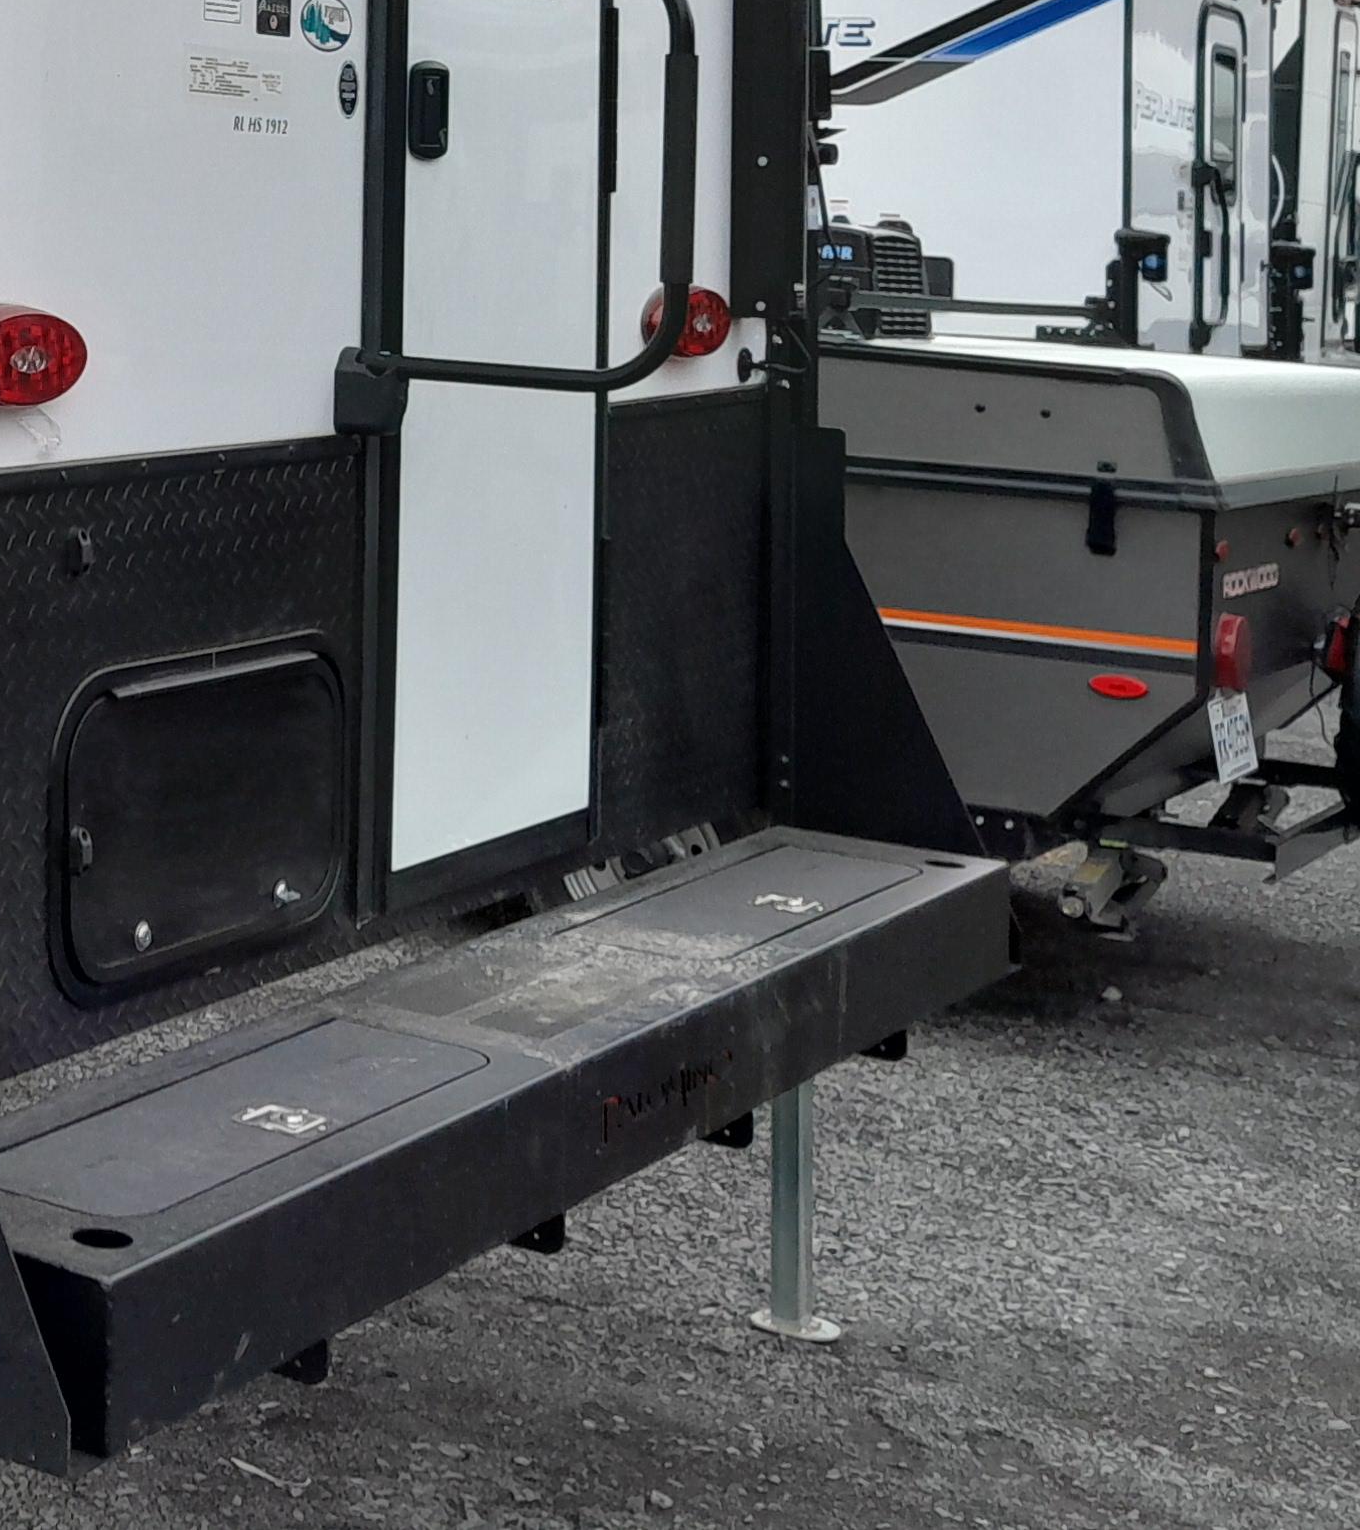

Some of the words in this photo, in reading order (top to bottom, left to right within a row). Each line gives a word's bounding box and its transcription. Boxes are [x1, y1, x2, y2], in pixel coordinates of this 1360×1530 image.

[233, 115, 245, 131] RL
[248, 117, 262, 133] HS
[266, 118, 288, 135] 1912
